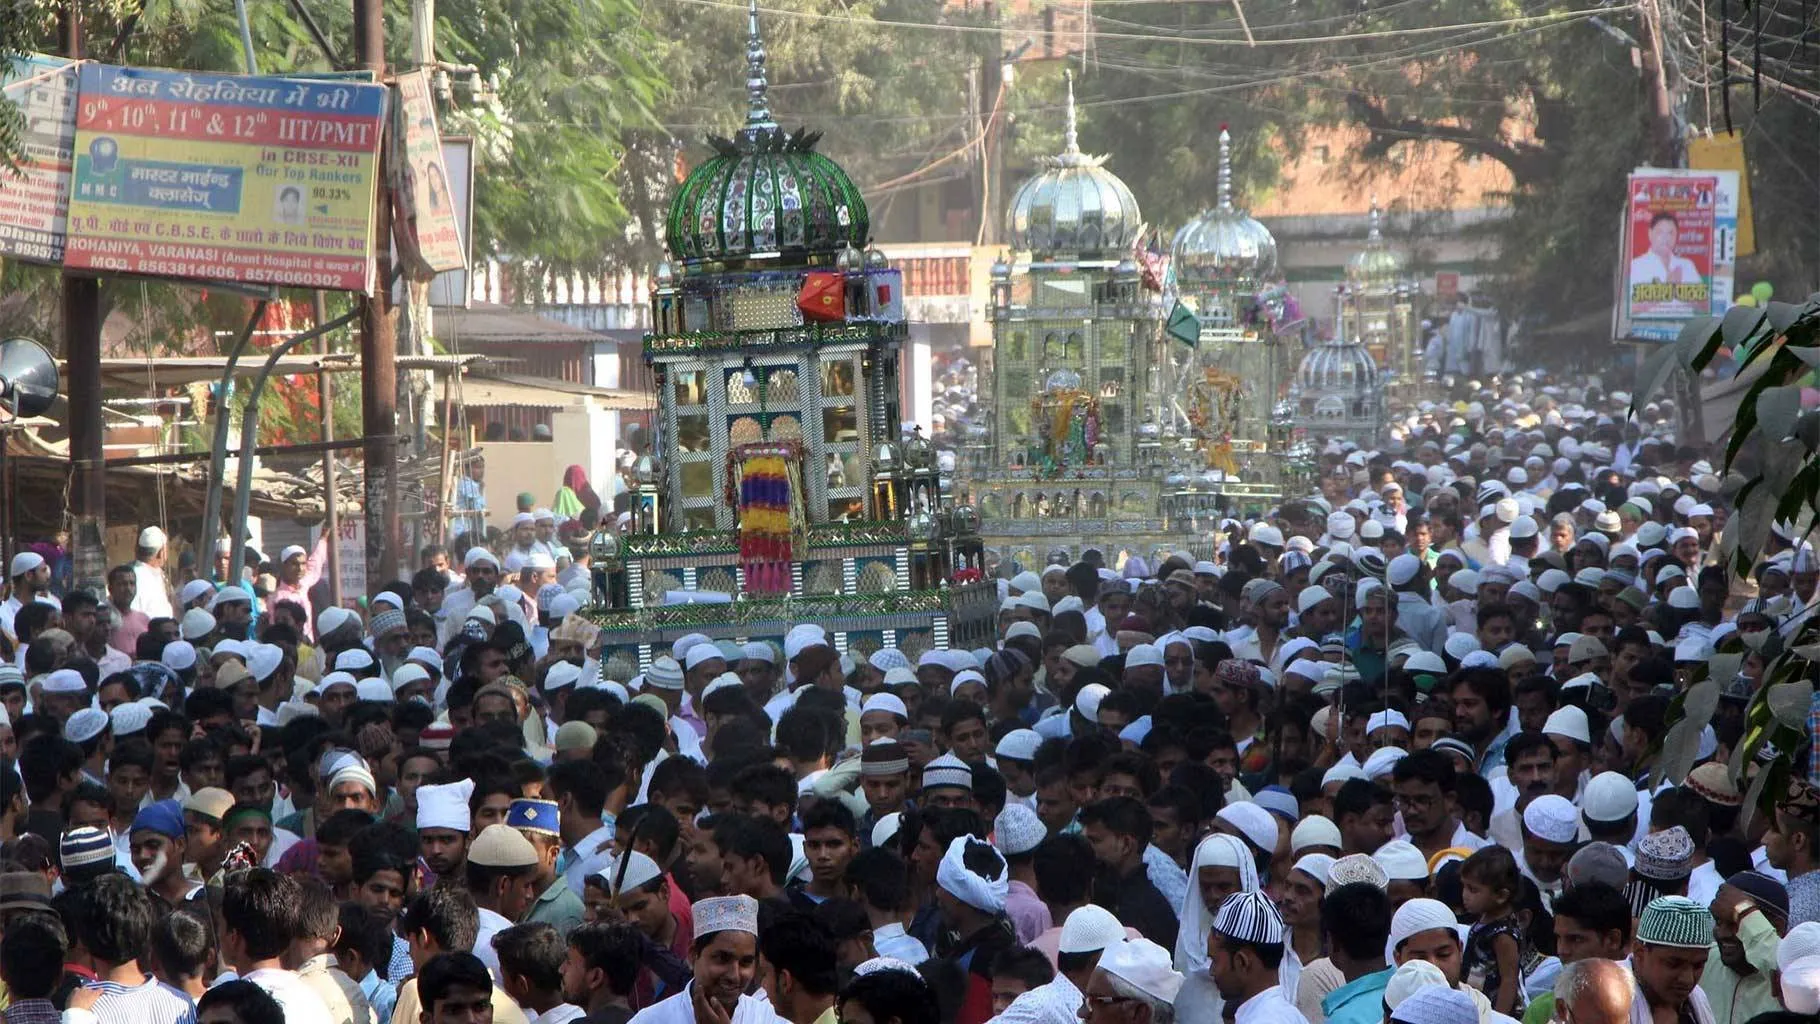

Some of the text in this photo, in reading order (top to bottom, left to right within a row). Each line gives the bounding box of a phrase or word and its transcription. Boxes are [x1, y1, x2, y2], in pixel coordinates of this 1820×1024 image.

[286, 85, 311, 107] में
[317, 88, 350, 109] भी
[167, 107, 201, 132] 11th
[206, 113, 224, 134] &
[234, 112, 267, 138] 12th
[279, 117, 371, 145] IIT/PMT
[262, 147, 360, 167] in CBSE-XII
[284, 167, 305, 180] Top
[310, 169, 363, 184] Rankers
[69, 237, 145, 258] ROHANIYA,
[149, 243, 218, 262] VARANASI
[263, 255, 312, 270] Hospital
[91, 255, 133, 270] MOB.
[245, 268, 342, 287] 8576060302
